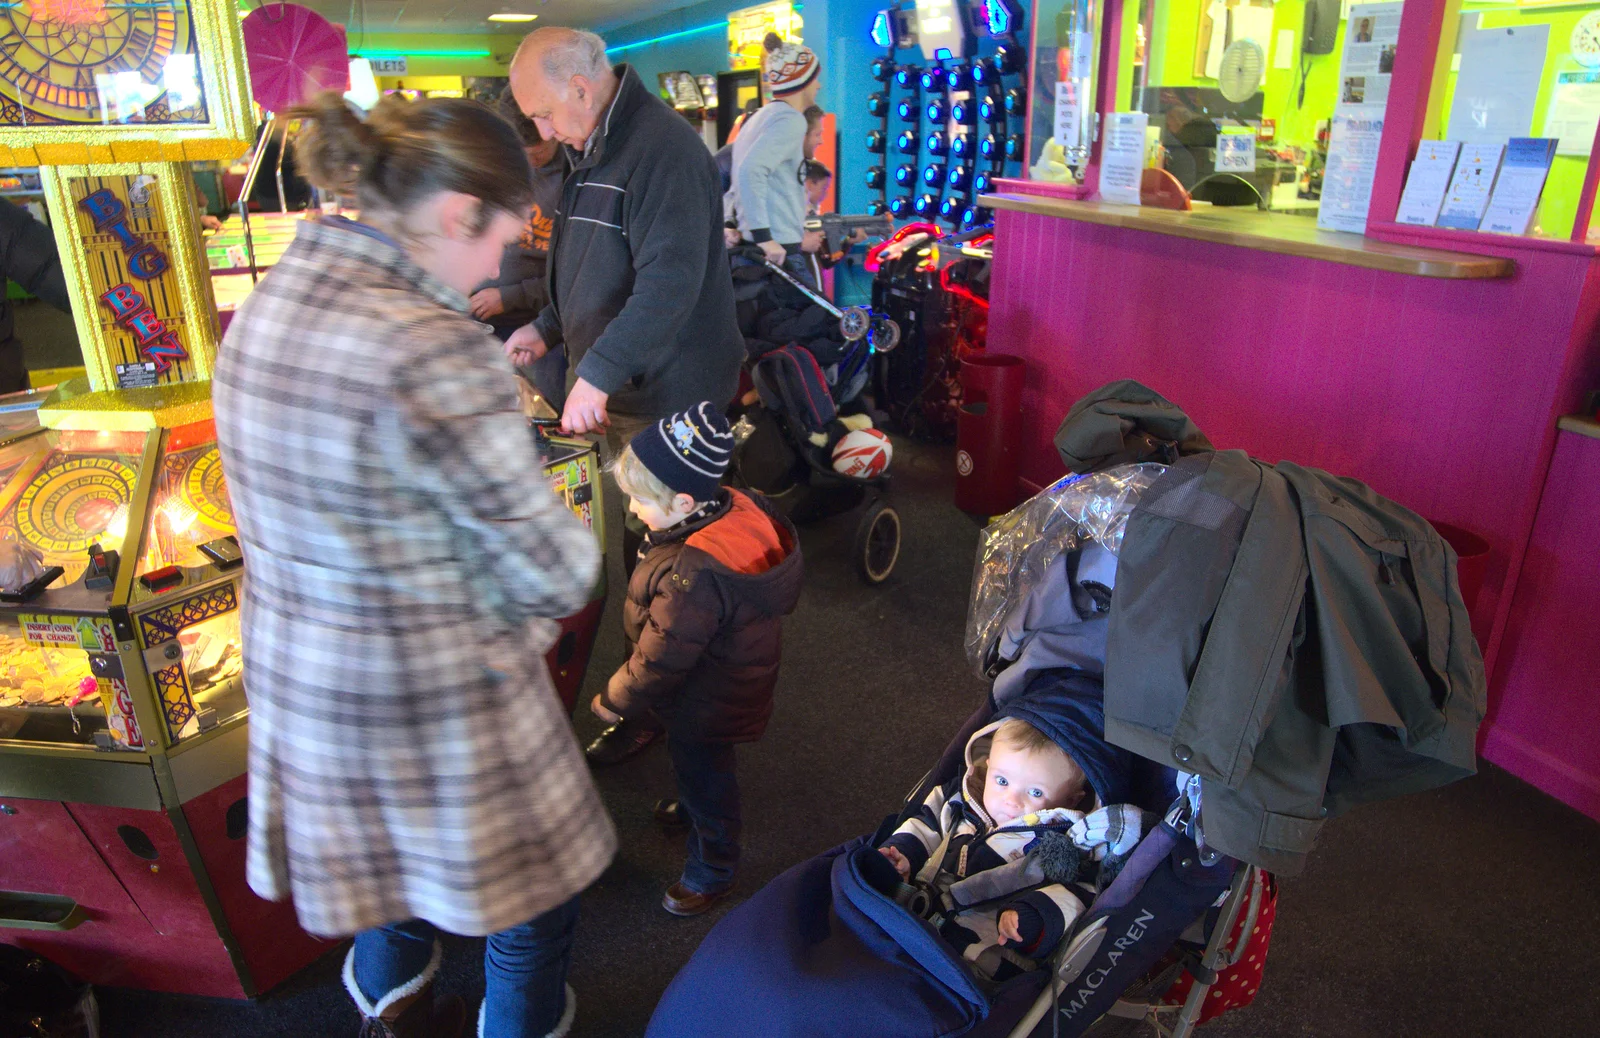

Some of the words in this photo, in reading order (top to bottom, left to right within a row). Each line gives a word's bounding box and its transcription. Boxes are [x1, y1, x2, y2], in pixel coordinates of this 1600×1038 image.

[369, 59, 406, 73] ILETS
[78, 187, 169, 281] BIG
[100, 282, 188, 374] BEN
[27, 623, 51, 632] INSERT
[54, 624, 73, 632] COIN
[46, 634, 77, 642] CHANGE
[101, 624, 142, 747] CHNGE
[1060, 908, 1155, 1019] MACLAREN
